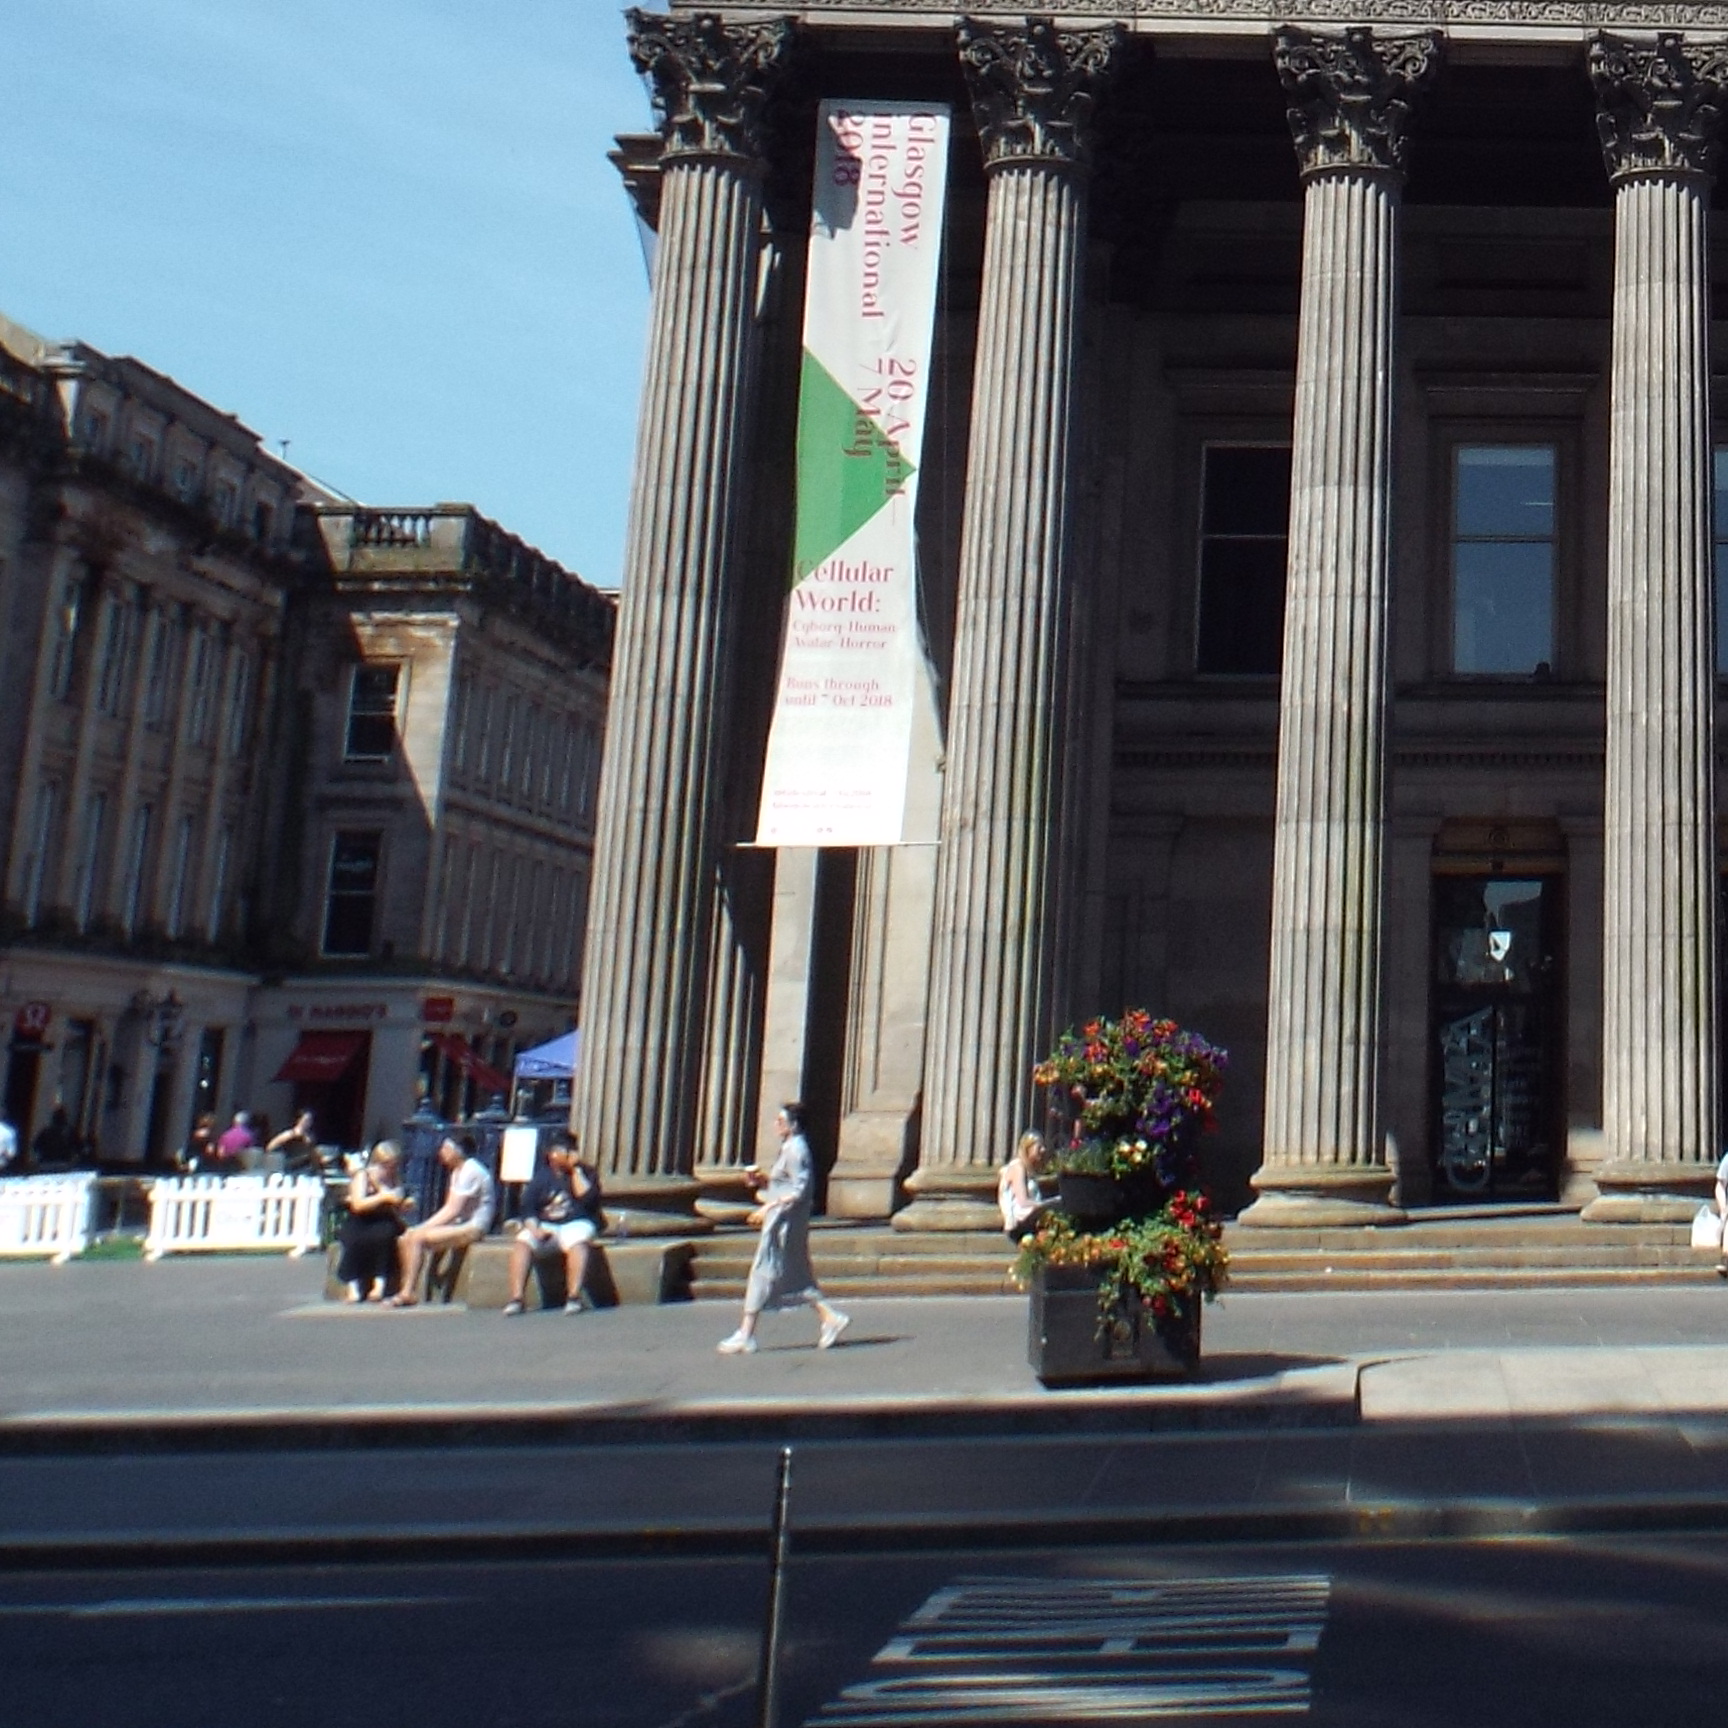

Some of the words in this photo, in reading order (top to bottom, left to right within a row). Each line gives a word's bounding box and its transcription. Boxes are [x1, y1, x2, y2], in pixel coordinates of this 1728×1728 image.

[832, 108, 867, 187] 2018
[892, 111, 938, 249] Glasgow
[861, 112, 897, 318] International
[858, 357, 882, 375] 7
[887, 357, 917, 401] 20
[841, 386, 882, 457] May
[877, 407, 910, 495] April
[796, 559, 894, 583] Cellular
[794, 590, 880, 613] World:
[824, 677, 879, 694] through
[860, 693, 893, 707] 2018
